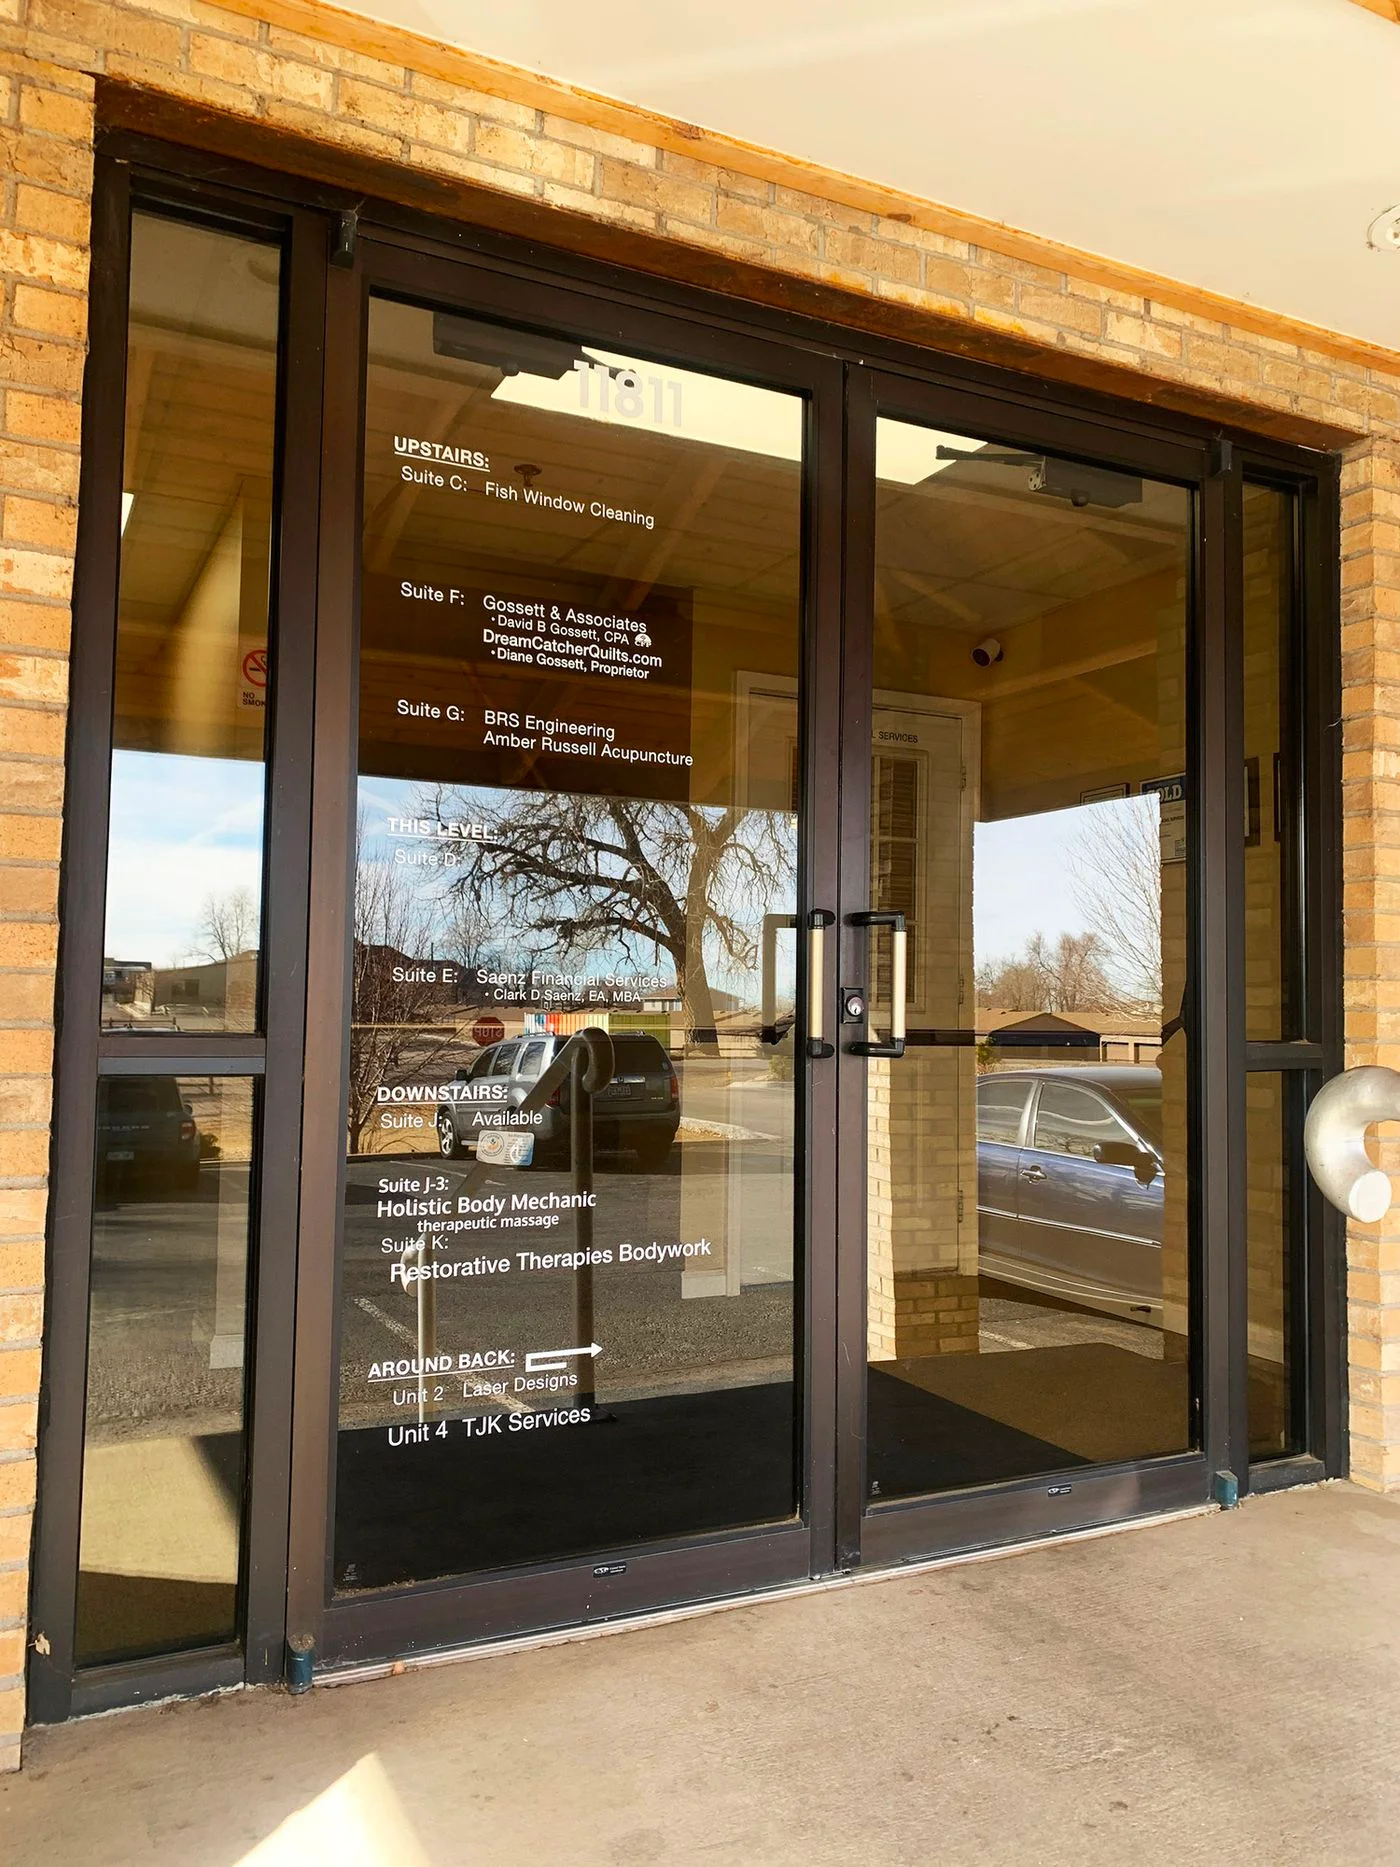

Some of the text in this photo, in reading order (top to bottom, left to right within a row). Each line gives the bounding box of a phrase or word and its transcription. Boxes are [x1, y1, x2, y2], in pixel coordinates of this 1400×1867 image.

[574, 360, 682, 428] 11811
[394, 436, 490, 469] UPSTAIRS:
[401, 465, 655, 529] Suite C: Fish Window Cleaning
[400, 582, 647, 633] Suite F: Gossett & Associates
[498, 615, 629, 645] David B Gossett, CPA
[483, 629, 662, 667] DreamCatcherQuilts.com
[497, 648, 650, 679] Diane Gossett, Proprietor
[397, 699, 615, 741] Suite G: BRS Engineering
[483, 731, 693, 767] Amber Russell Acupuncture
[878, 731, 918, 743] SERVICES
[387, 817, 498, 840] THIS LEVEL:
[394, 849, 443, 867] Suite
[392, 967, 668, 988] Suite E: Saenz Financial Services
[493, 988, 641, 1003] Clark D Saenz, EA, MBA
[377, 1085, 508, 1101] DOWNSTAIRS:
[380, 1110, 543, 1128] Suite J: Available
[378, 1177, 449, 1194] Suite J-3:
[377, 1190, 597, 1218] Holistic Body Mechanic
[417, 1213, 560, 1234] therapeutic massage
[381, 1234, 449, 1254] Suite K:
[390, 1238, 712, 1283] Restorative Therapies Bodywork
[368, 1349, 515, 1379] AROUND BACK:
[393, 1373, 578, 1406] Unit 2 Laser Designs
[388, 1407, 591, 1447] Unit 4 TJK Services
